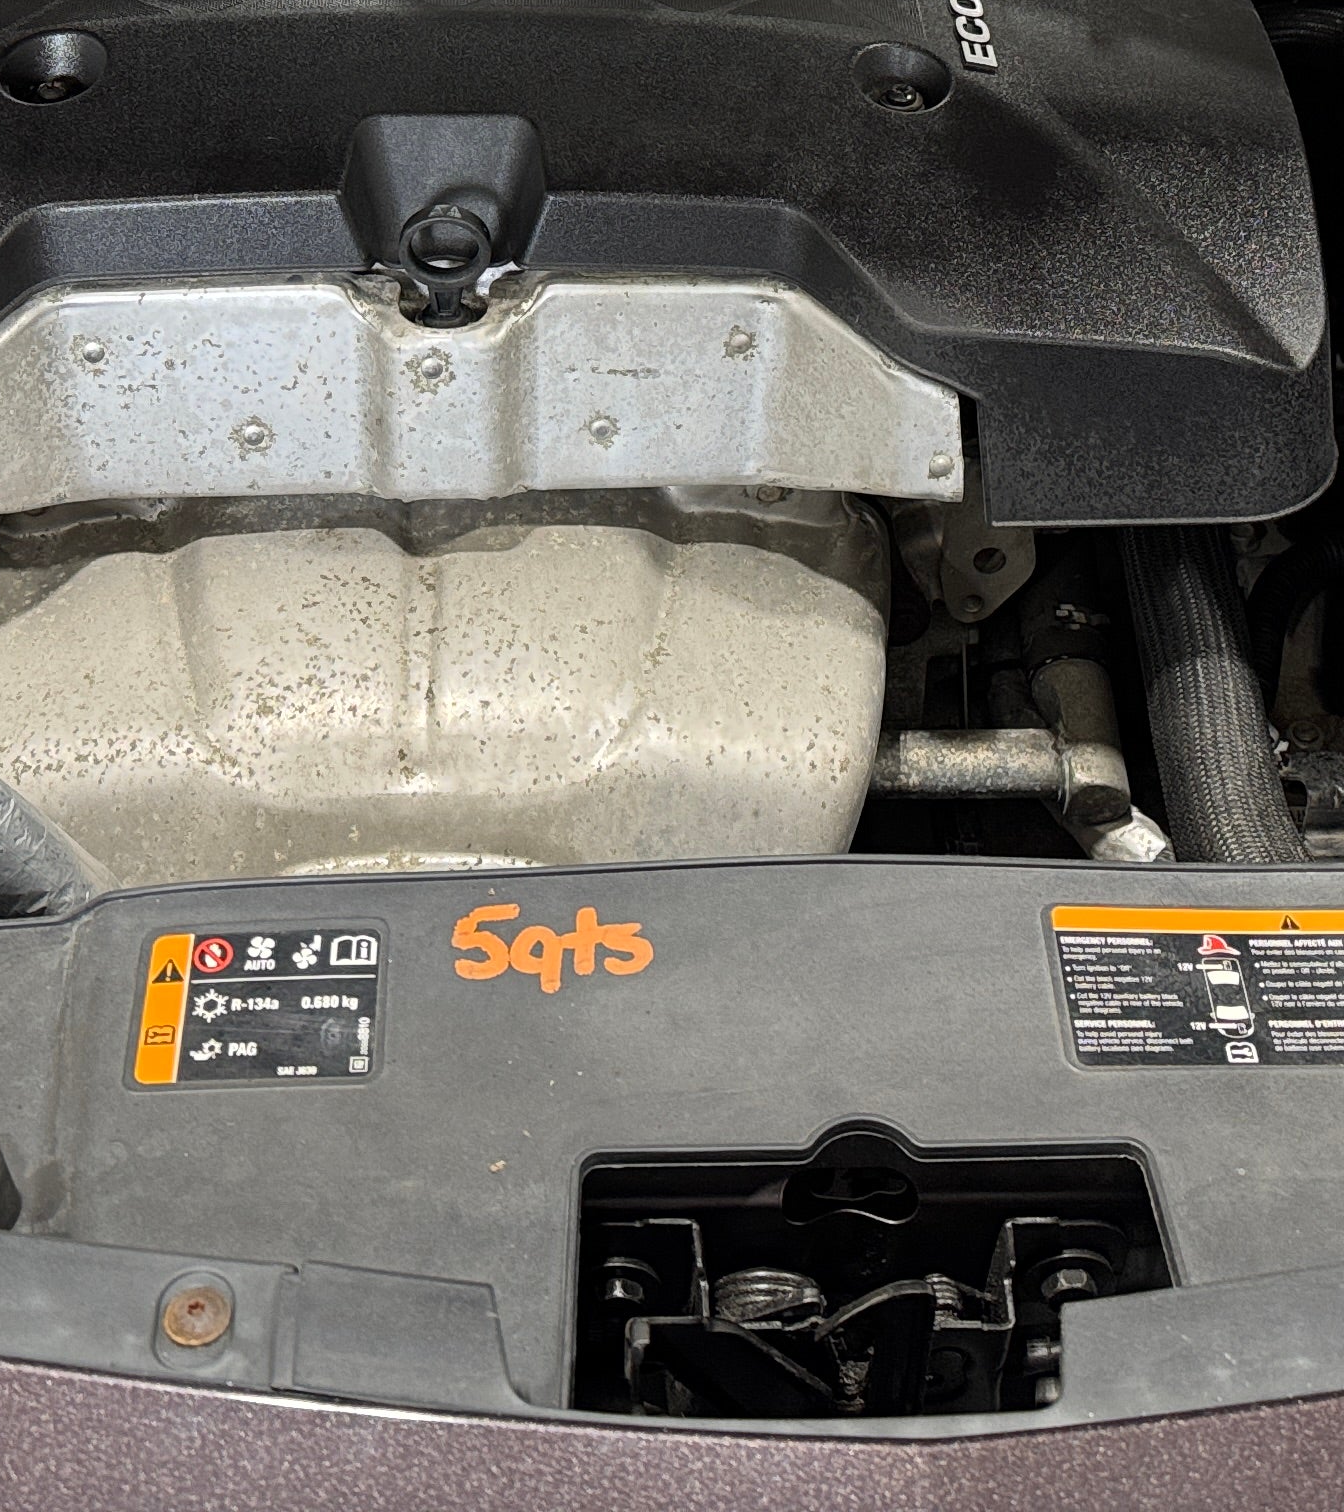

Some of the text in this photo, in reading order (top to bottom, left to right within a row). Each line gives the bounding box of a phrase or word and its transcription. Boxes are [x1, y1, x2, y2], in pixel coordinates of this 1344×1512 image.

[244, 959, 275, 971] AUTO
[1177, 963, 1193, 971] 12V
[231, 996, 358, 1011] R-134a 0.680 kg
[1190, 1022, 1206, 1030] 12V
[228, 1042, 257, 1056] PAG
